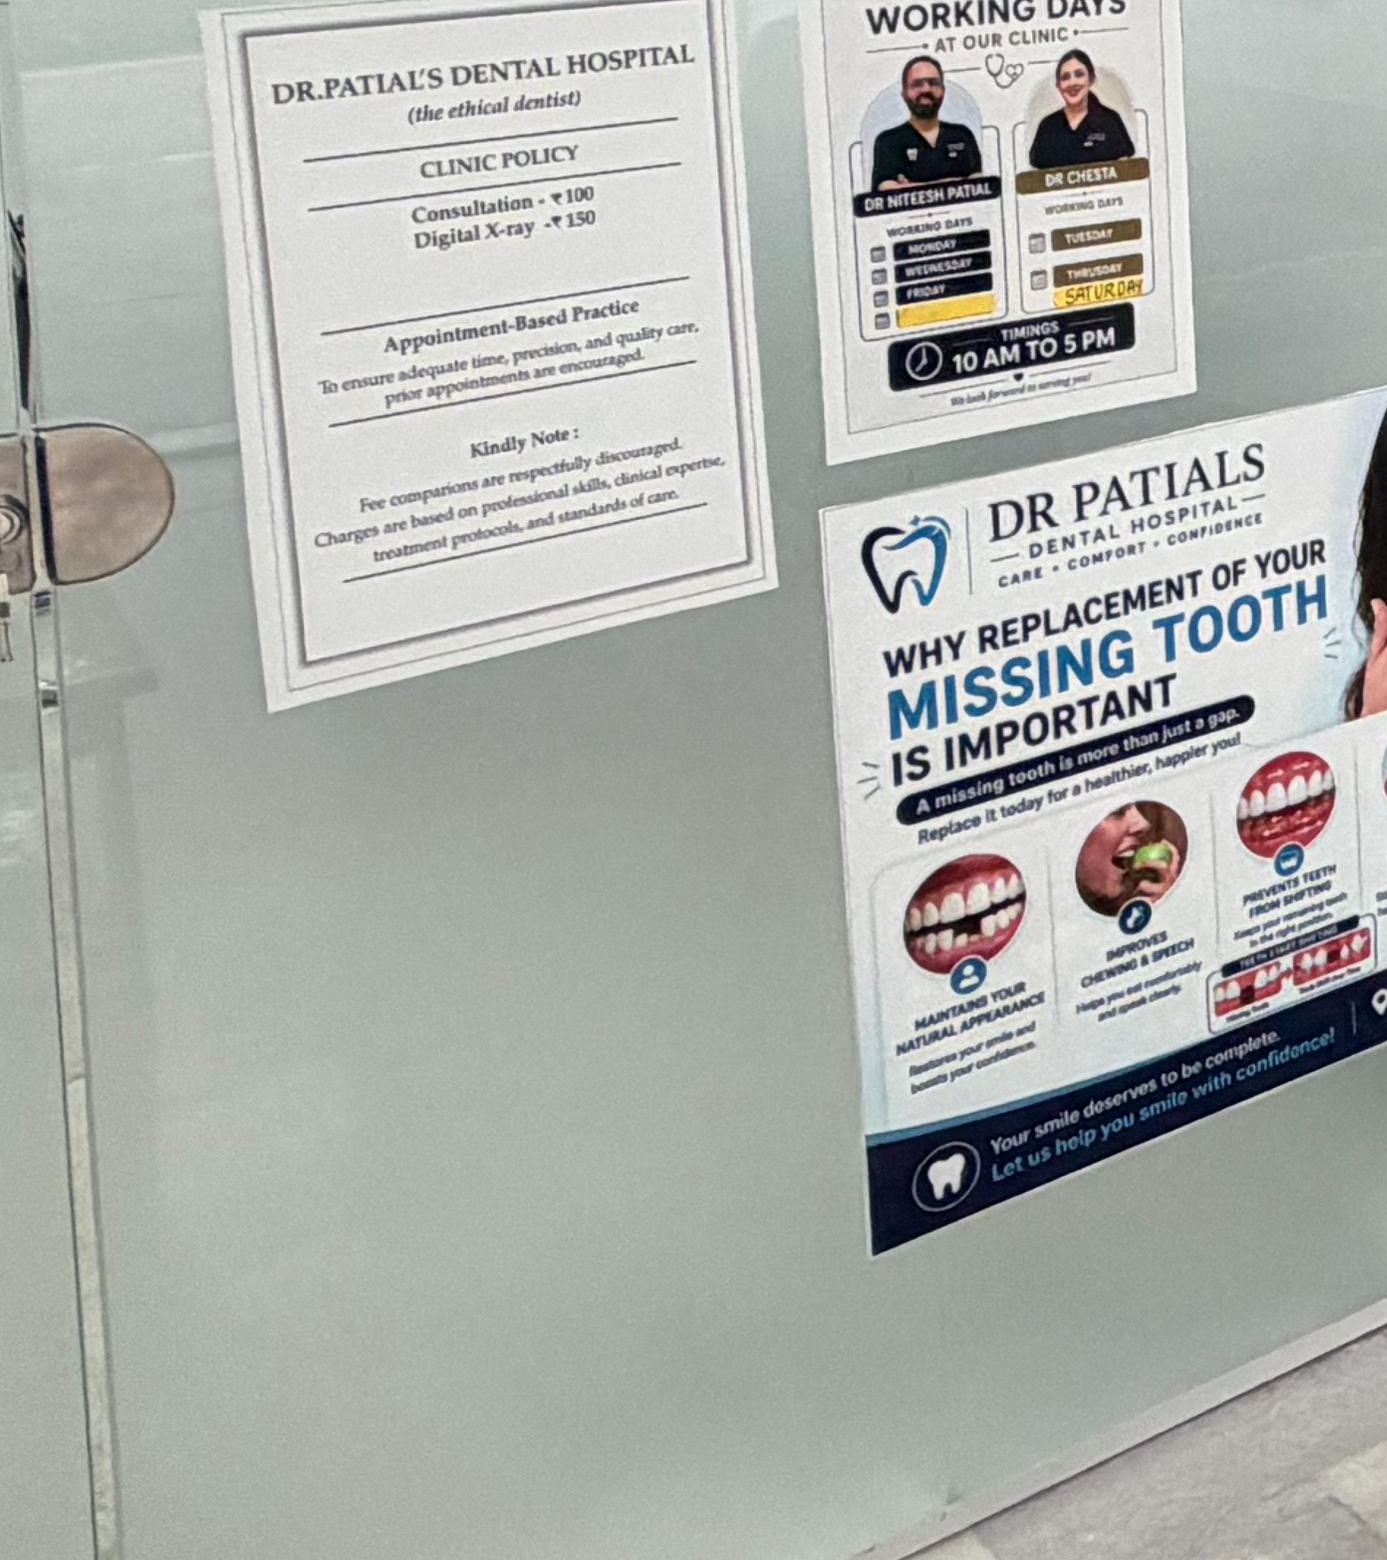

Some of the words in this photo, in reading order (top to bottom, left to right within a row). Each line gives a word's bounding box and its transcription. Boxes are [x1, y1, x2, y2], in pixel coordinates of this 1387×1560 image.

[935, 38, 958, 53] AT
[963, 34, 1003, 51] OUR
[1009, 28, 1069, 46] CLINIC
[271, 67, 444, 106] DR.PATIAL'S
[451, 58, 562, 87] DENTAL
[566, 45, 695, 75] HOSPITAL
[407, 104, 443, 125] (the
[448, 97, 509, 119] ethical
[514, 90, 582, 114] dentist)
[420, 155, 497, 179] CLINIC
[502, 145, 578, 169] POLICY
[1045, 172, 1064, 187] DR
[1067, 167, 1117, 184] CHESTA
[411, 195, 533, 224] Consultation
[865, 198, 883, 211] DR
[887, 188, 945, 209] NITEESH
[948, 182, 992, 201] PATIAL
[1045, 200, 1095, 215] WORKING
[1098, 197, 1123, 208] DAYS
[415, 226, 480, 251] Digital
[484, 220, 535, 240] X-ray
[886, 221, 942, 237] WORKING
[946, 217, 973, 229] DAYS
[908, 240, 957, 254] MONDAY
[1065, 229, 1113, 245] TUESDAY
[905, 258, 972, 276] WEDNESDAY
[906, 284, 946, 297] FRIDAY
[1065, 279, 1143, 305] SATURDAY
[384, 312, 568, 356] Appointment-Based
[572, 298, 639, 325] Practice
[952, 351, 978, 373] 10
[983, 344, 1021, 368] AM
[1025, 339, 1057, 362] TO
[1064, 333, 1077, 353] 5
[1082, 327, 1115, 351] PM
[1001, 321, 1060, 341] TIMINGS
[318, 379, 338, 395] To
[341, 373, 395, 392] ensure
[398, 359, 468, 383] adequate
[472, 352, 510, 370] time,
[513, 342, 582, 366] precision,
[585, 333, 612, 349] and
[616, 325, 663, 348] quality
[384, 387, 422, 409] prior
[427, 369, 530, 400] appointments
[534, 365, 556, 379] are
[559, 350, 645, 377] encouraged.
[470, 436, 526, 459] Kindly
[531, 428, 569, 447] Note
[359, 495, 386, 513] Fee
[482, 474, 505, 488] are
[509, 456, 592, 485] respectfully
[595, 438, 683, 467] discouraged.
[989, 493, 1059, 542] DR
[1073, 444, 1265, 521] PATIALS
[314, 525, 379, 552] Charges
[383, 516, 407, 534] are
[411, 508, 454, 529] based
[458, 506, 478, 518] on
[482, 486, 569, 518] professional
[573, 476, 611, 496] skills,
[614, 465, 662, 488] clinical
[372, 537, 448, 561] treatment
[451, 520, 524, 550] protocols,
[527, 515, 554, 529] and
[558, 499, 627, 523] standards
[630, 495, 644, 509] of
[1028, 522, 1121, 559] DENTAL
[1130, 495, 1236, 535] HOSPITAL
[998, 565, 1043, 588] CARE
[1067, 542, 1147, 572] COMFORT
[1166, 513, 1263, 548] CONFIDENCE
[883, 631, 965, 678] WHY
[977, 569, 1203, 655] REPLACEMENT
[1211, 559, 1247, 592] OF
[1253, 539, 1327, 581] YOUR
[887, 629, 1135, 742] MISSING
[1152, 574, 1328, 663] TOOTH
[891, 746, 931, 787] IS
[944, 674, 1178, 773] IMPORTANT
[915, 798, 929, 815] A
[935, 778, 1004, 809] missing
[1009, 760, 1055, 788] tooth
[1060, 756, 1074, 773] is
[1077, 743, 1119, 768] more
[1123, 731, 1159, 753] than
[1162, 723, 1192, 748] just
[1195, 718, 1205, 731] a
[1208, 707, 1240, 731] gap.
[917, 814, 982, 844] Replace
[985, 808, 997, 825] it
[1000, 796, 1044, 820] today
[1047, 791, 1068, 809] for
[1072, 784, 1082, 797] a
[1085, 761, 1152, 794] healthier,
[1155, 746, 1207, 772] happier
[1211, 731, 1241, 758] you!
[990, 1133, 1030, 1157] Your
[1035, 1108, 1079, 1140] smile
[1083, 1084, 1157, 1120] deserves
[1161, 1075, 1178, 1093] to
[1181, 1062, 1202, 1084] be
[1205, 1028, 1280, 1071] complete.
[992, 1153, 1023, 1181] Let
[1027, 1148, 1051, 1166] us
[1055, 1128, 1096, 1157] help
[1100, 1112, 1135, 1142] you
[1139, 1092, 1188, 1126] smile
[1191, 1071, 1231, 1104] with
[1235, 1027, 1335, 1087] confidence!
